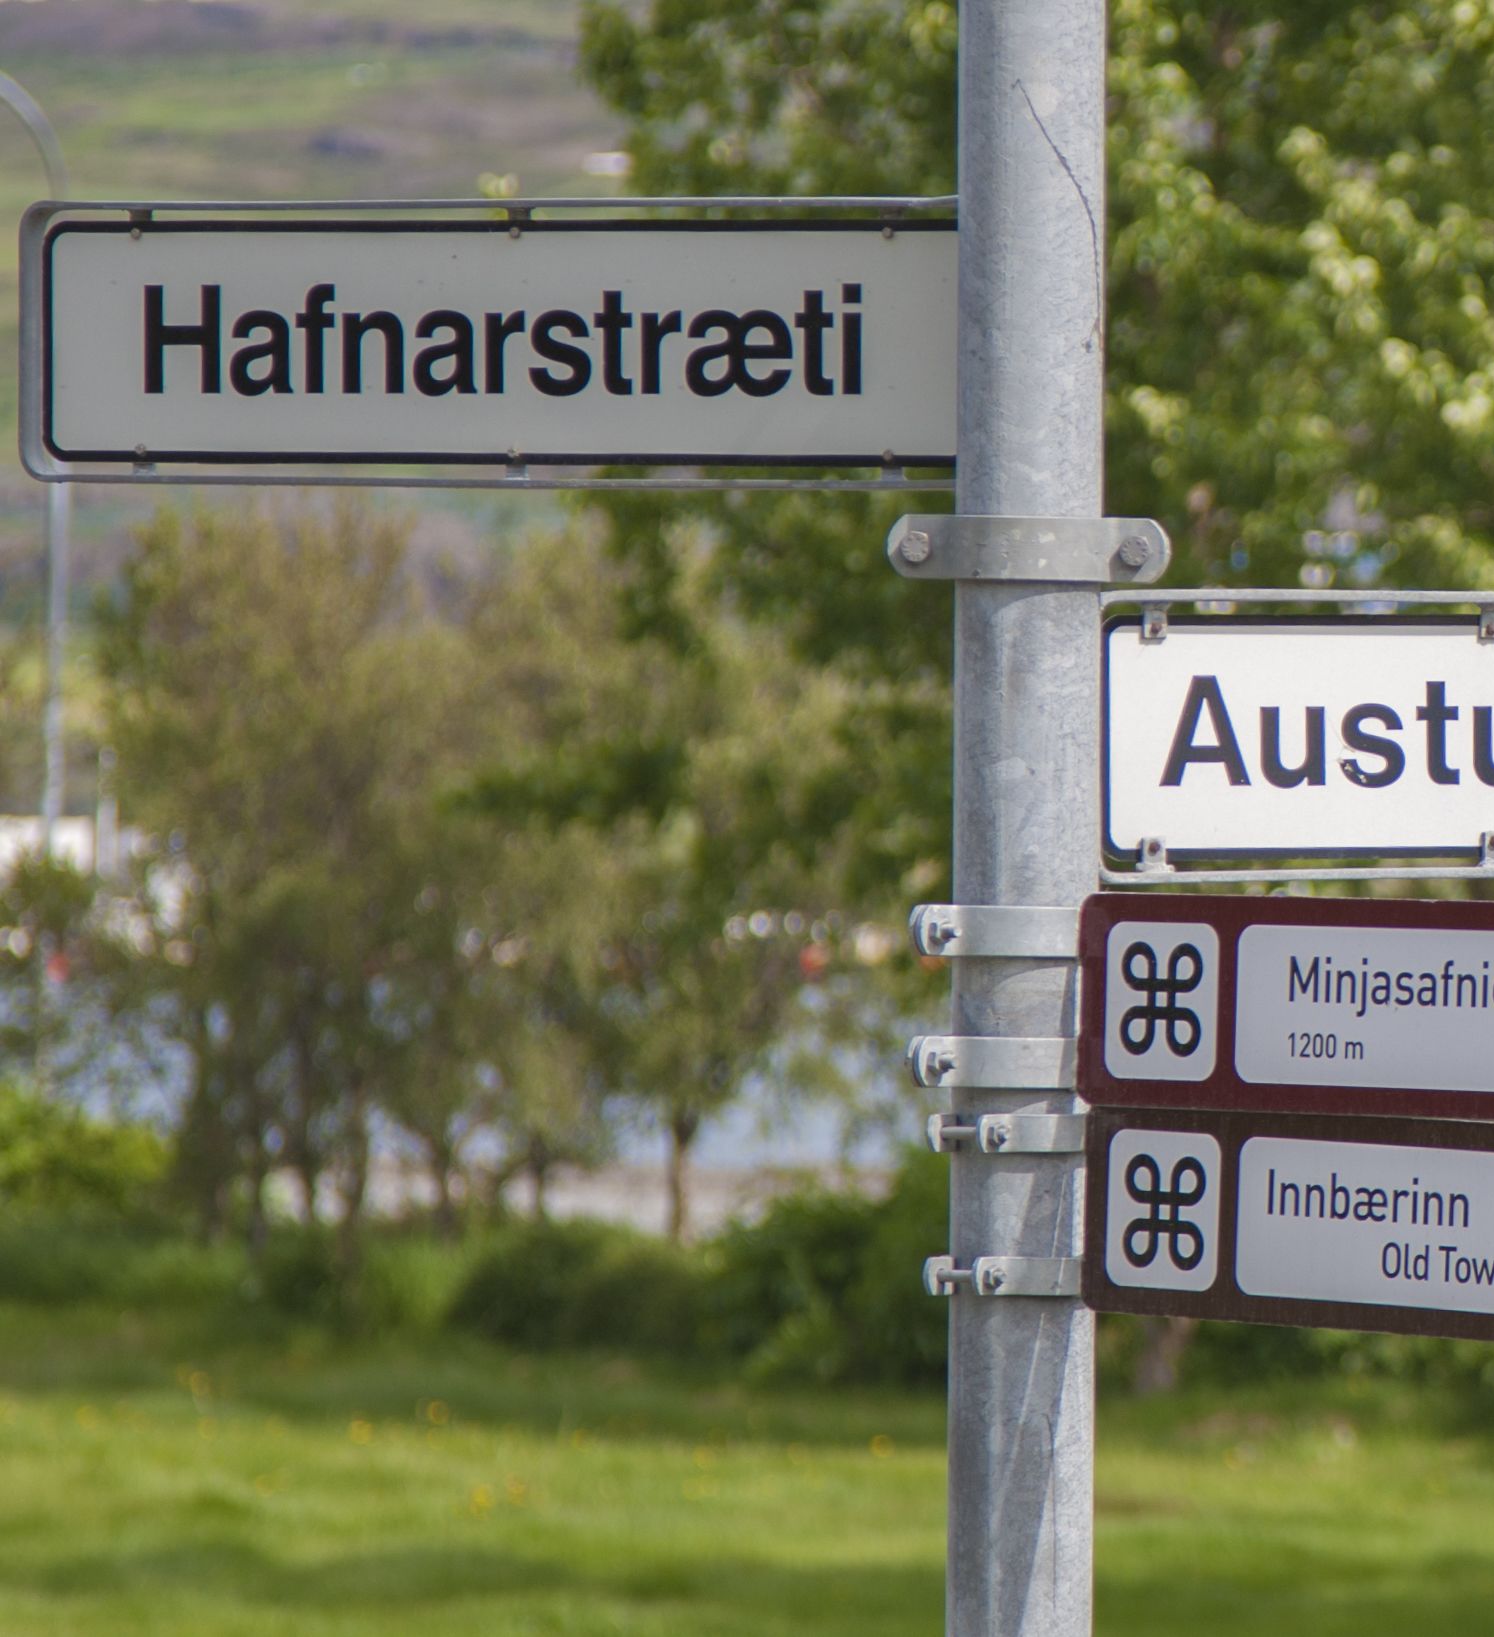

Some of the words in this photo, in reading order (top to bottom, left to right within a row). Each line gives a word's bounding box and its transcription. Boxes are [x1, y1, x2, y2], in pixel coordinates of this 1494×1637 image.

[144, 283, 862, 398] Hafnarstræti
[1287, 1032, 1337, 1060] 1200
[1344, 1041, 1364, 1060] m
[1267, 1168, 1469, 1228] Innbærinn
[1381, 1241, 1430, 1281] Old
